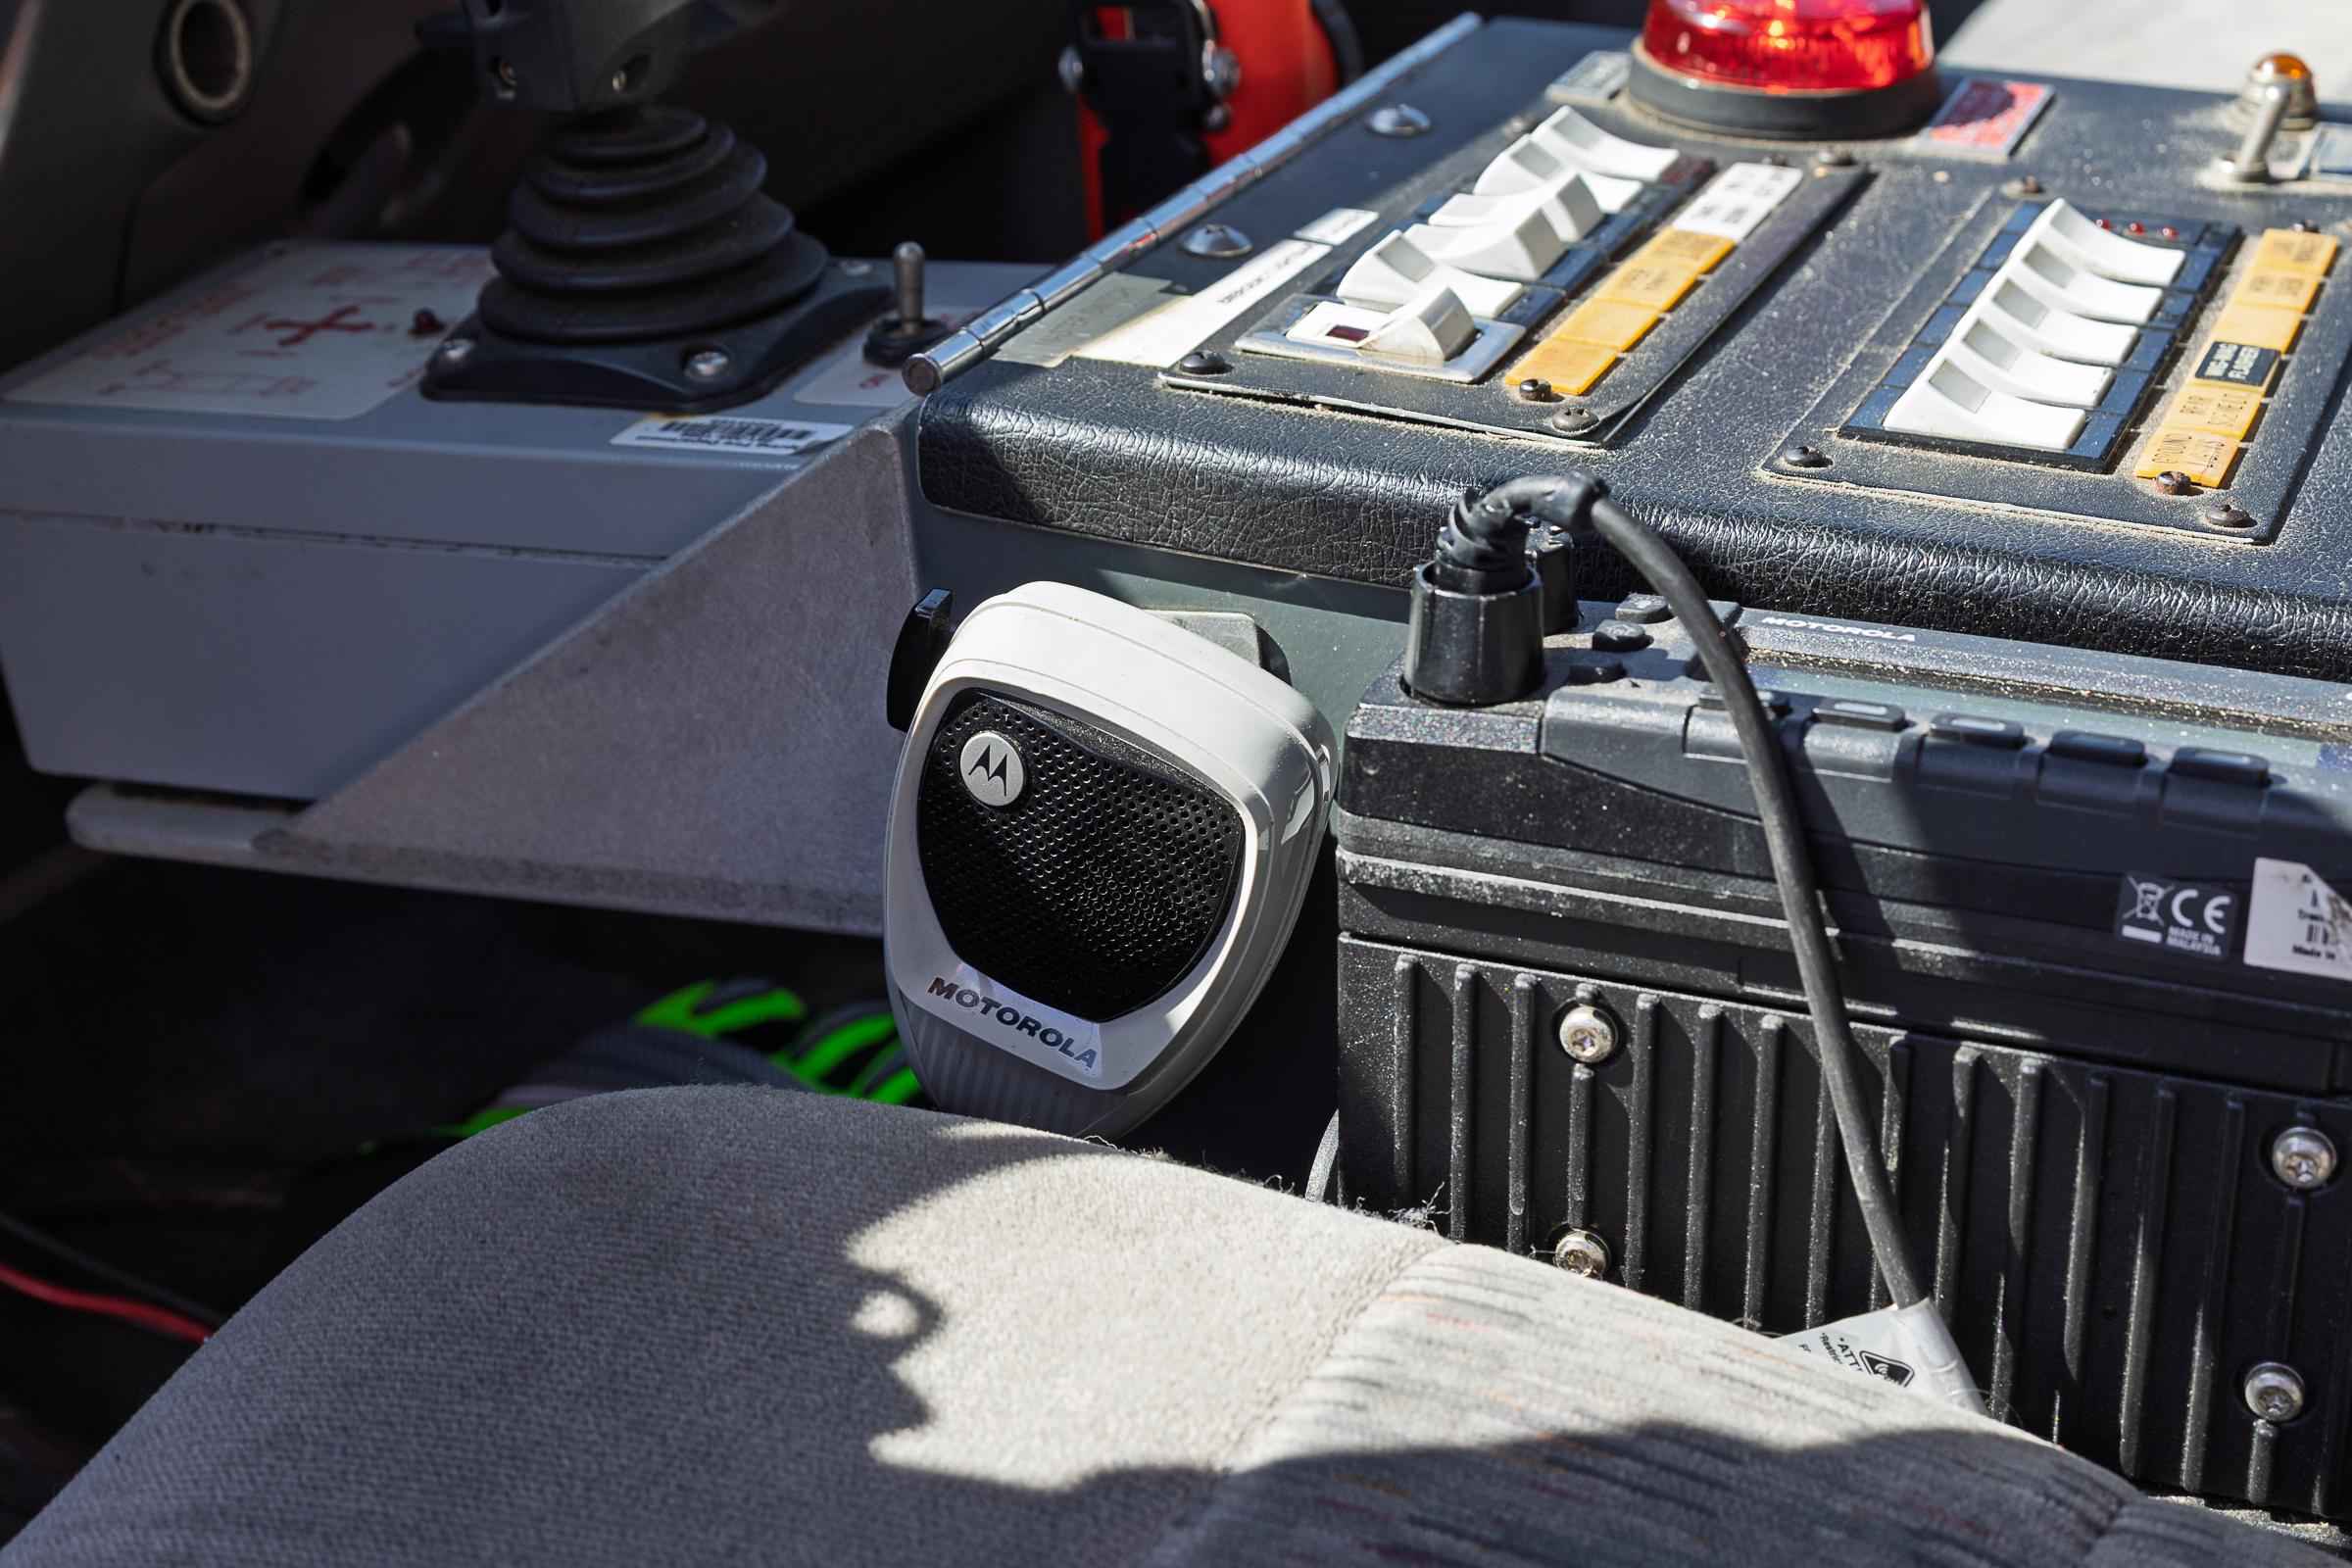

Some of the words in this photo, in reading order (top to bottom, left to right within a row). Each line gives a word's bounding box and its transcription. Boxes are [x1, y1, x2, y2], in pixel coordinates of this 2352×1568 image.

[1761, 616, 1916, 642] MOTOROLA
[2167, 936, 2222, 957] MALAYSIA
[2169, 925, 2200, 942] MADE
[2201, 931, 2216, 946] IN
[927, 976, 1098, 1069] MOTOROLA
